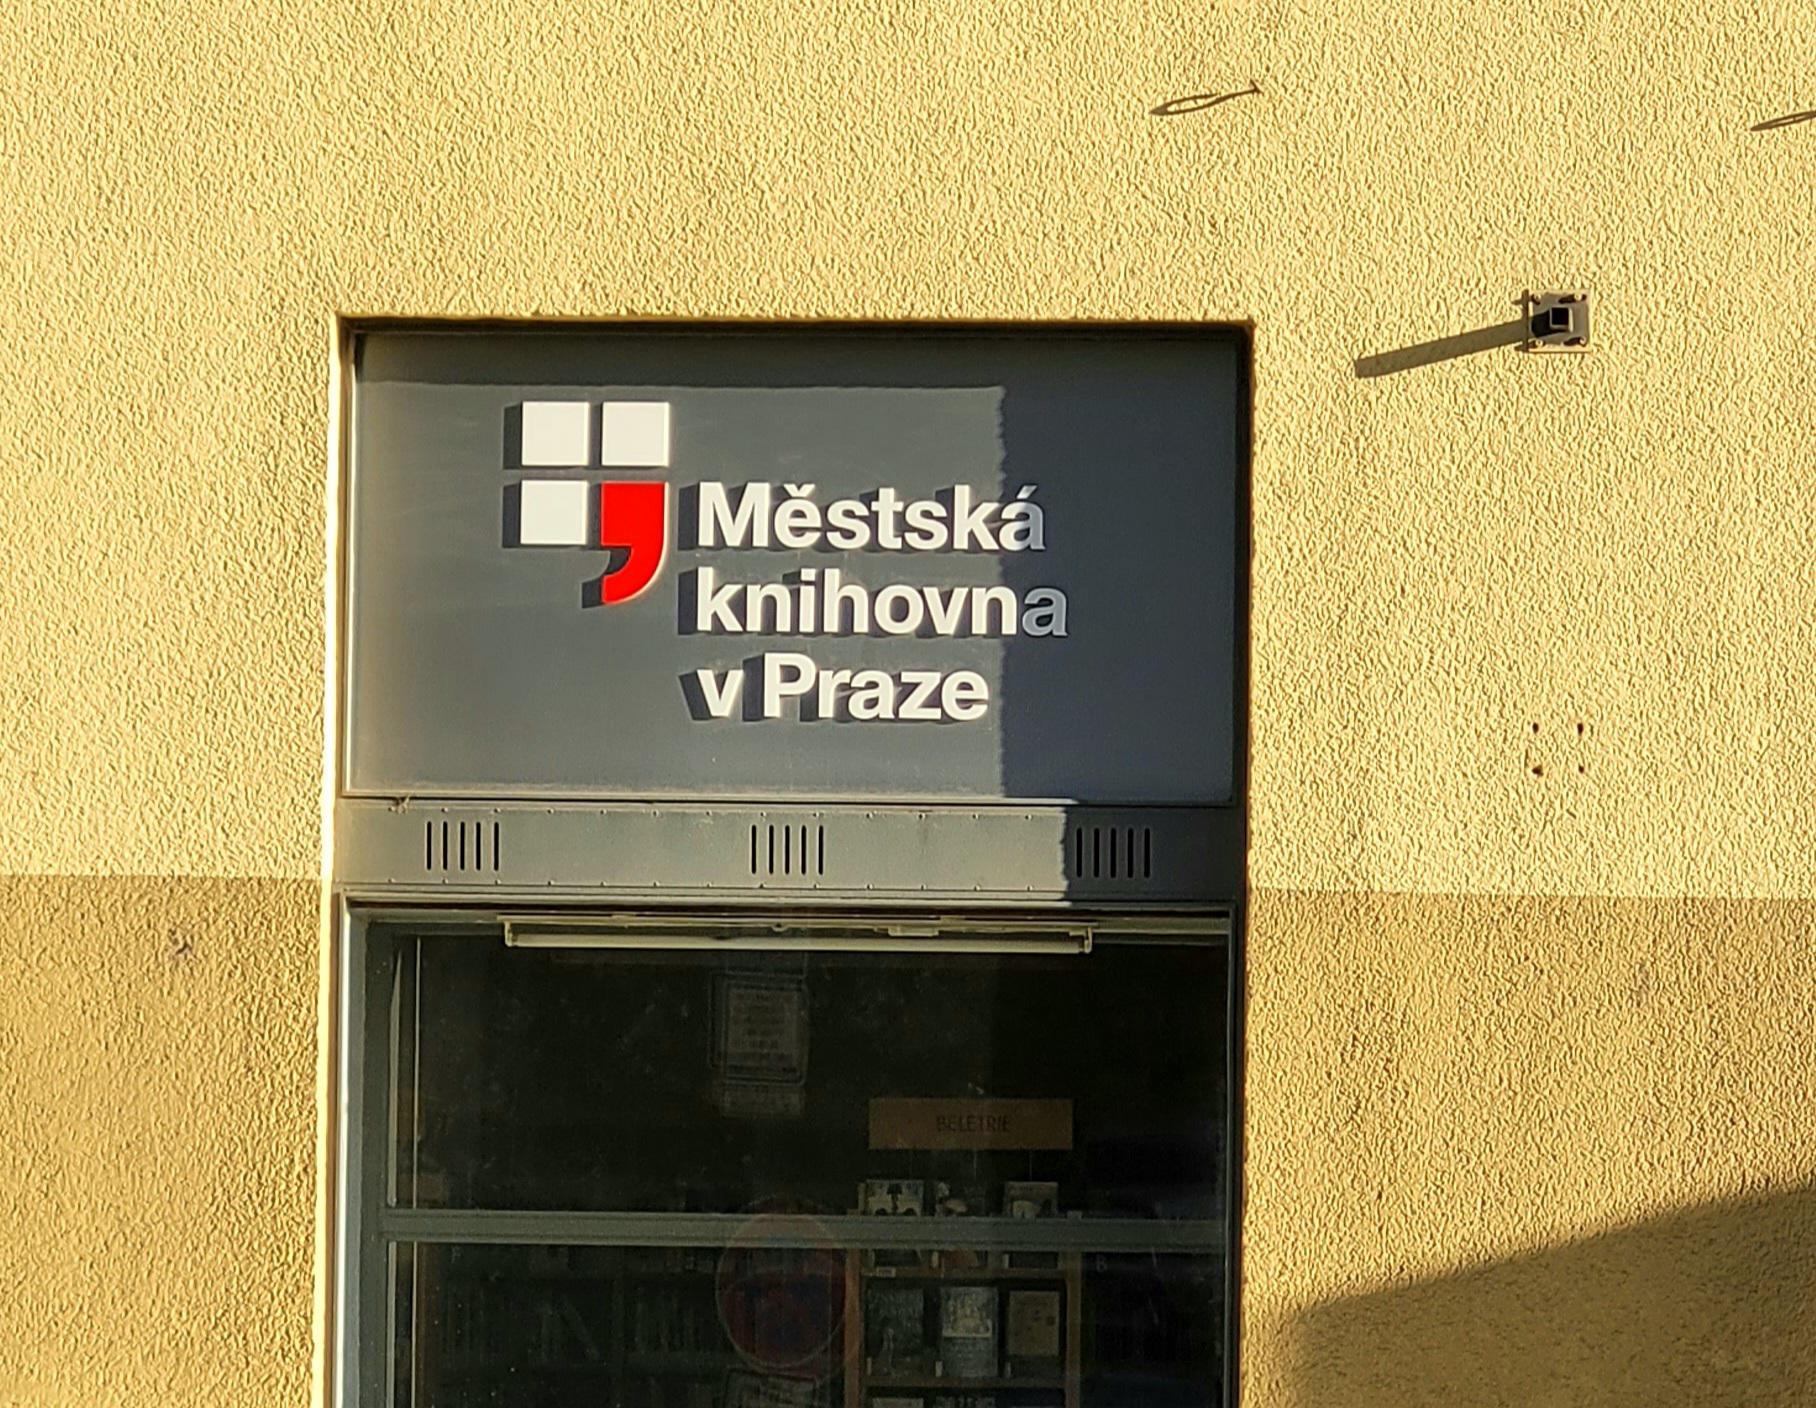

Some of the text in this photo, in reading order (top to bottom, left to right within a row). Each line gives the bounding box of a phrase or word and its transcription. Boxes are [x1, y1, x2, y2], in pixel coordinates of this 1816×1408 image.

[699, 482, 1046, 552] Městská
[697, 566, 1068, 636] knihovna
[697, 653, 990, 720] v Praze
[936, 1114, 1011, 1133] BELETRIE
